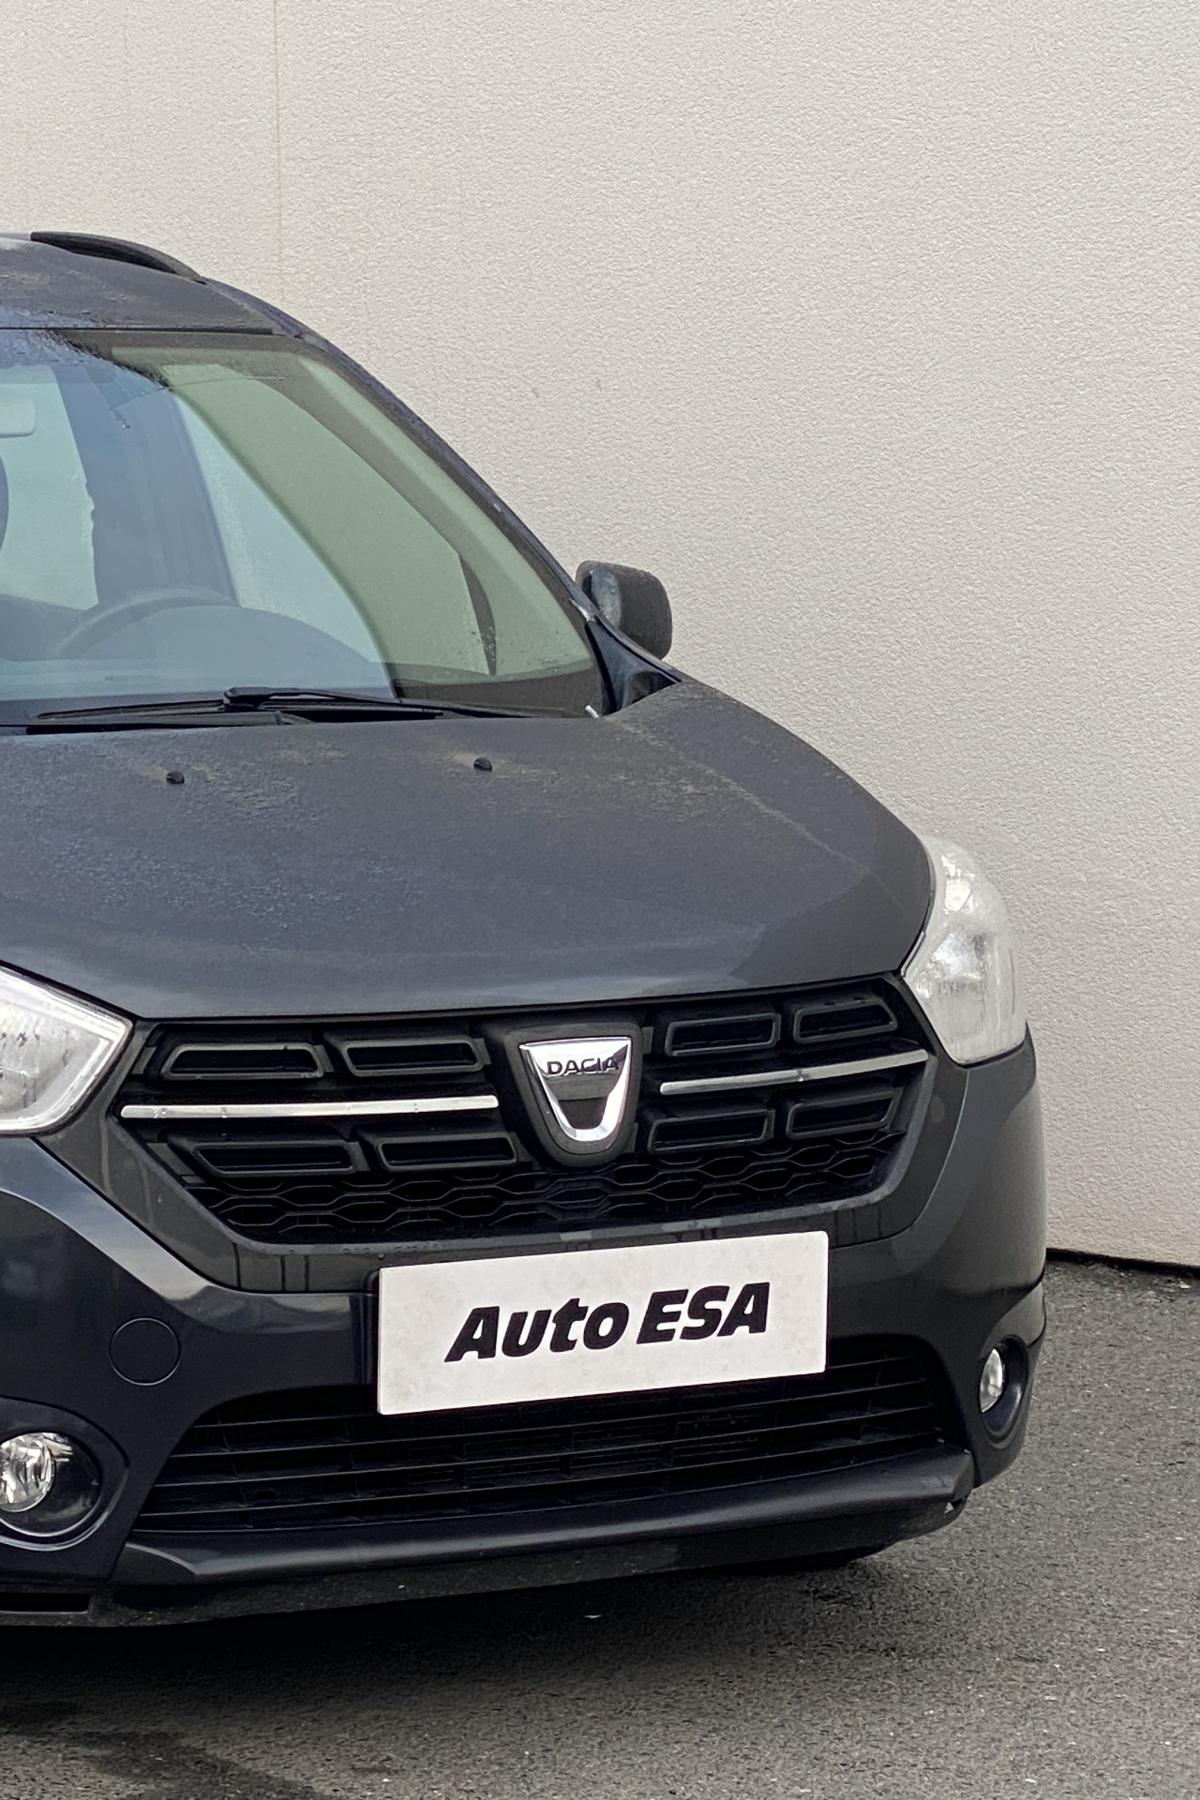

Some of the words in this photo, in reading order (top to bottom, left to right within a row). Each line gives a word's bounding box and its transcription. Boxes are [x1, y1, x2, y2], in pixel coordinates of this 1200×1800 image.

[547, 1057, 619, 1075] DACIA
[444, 1298, 630, 1363] Auto
[636, 1281, 770, 1345] ESA
